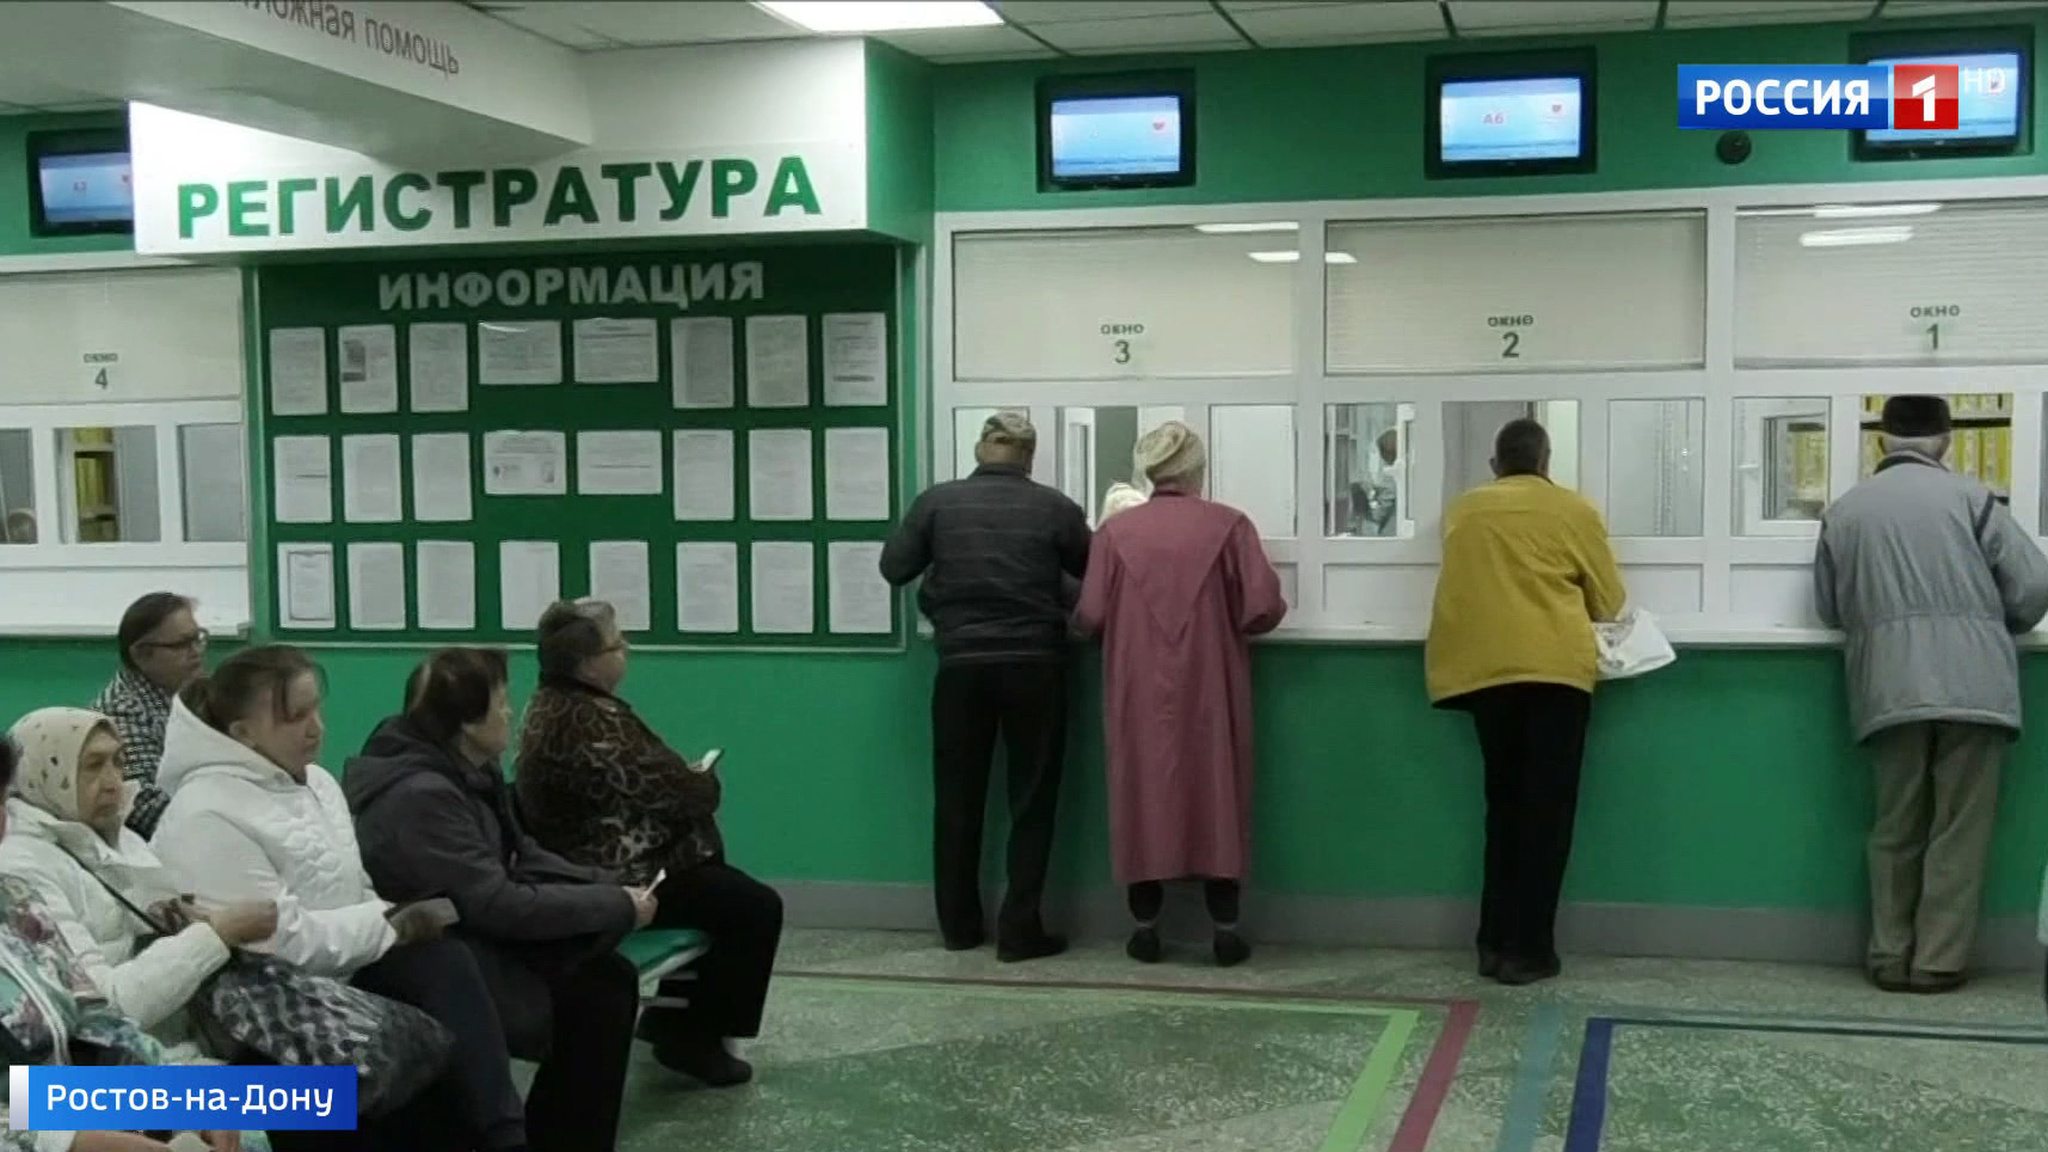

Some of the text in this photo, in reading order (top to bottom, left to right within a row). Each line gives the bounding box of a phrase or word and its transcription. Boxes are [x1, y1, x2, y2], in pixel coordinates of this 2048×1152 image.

[364, 18, 460, 76] помощь
[177, 156, 822, 240] РЕГИСТРАТУРА
[378, 261, 765, 311] ИНФОРМАЦИЯ
[1502, 331, 1520, 359] 2
[1926, 323, 1939, 351] 1
[1115, 339, 1131, 365] 3
[94, 367, 109, 390] 4
